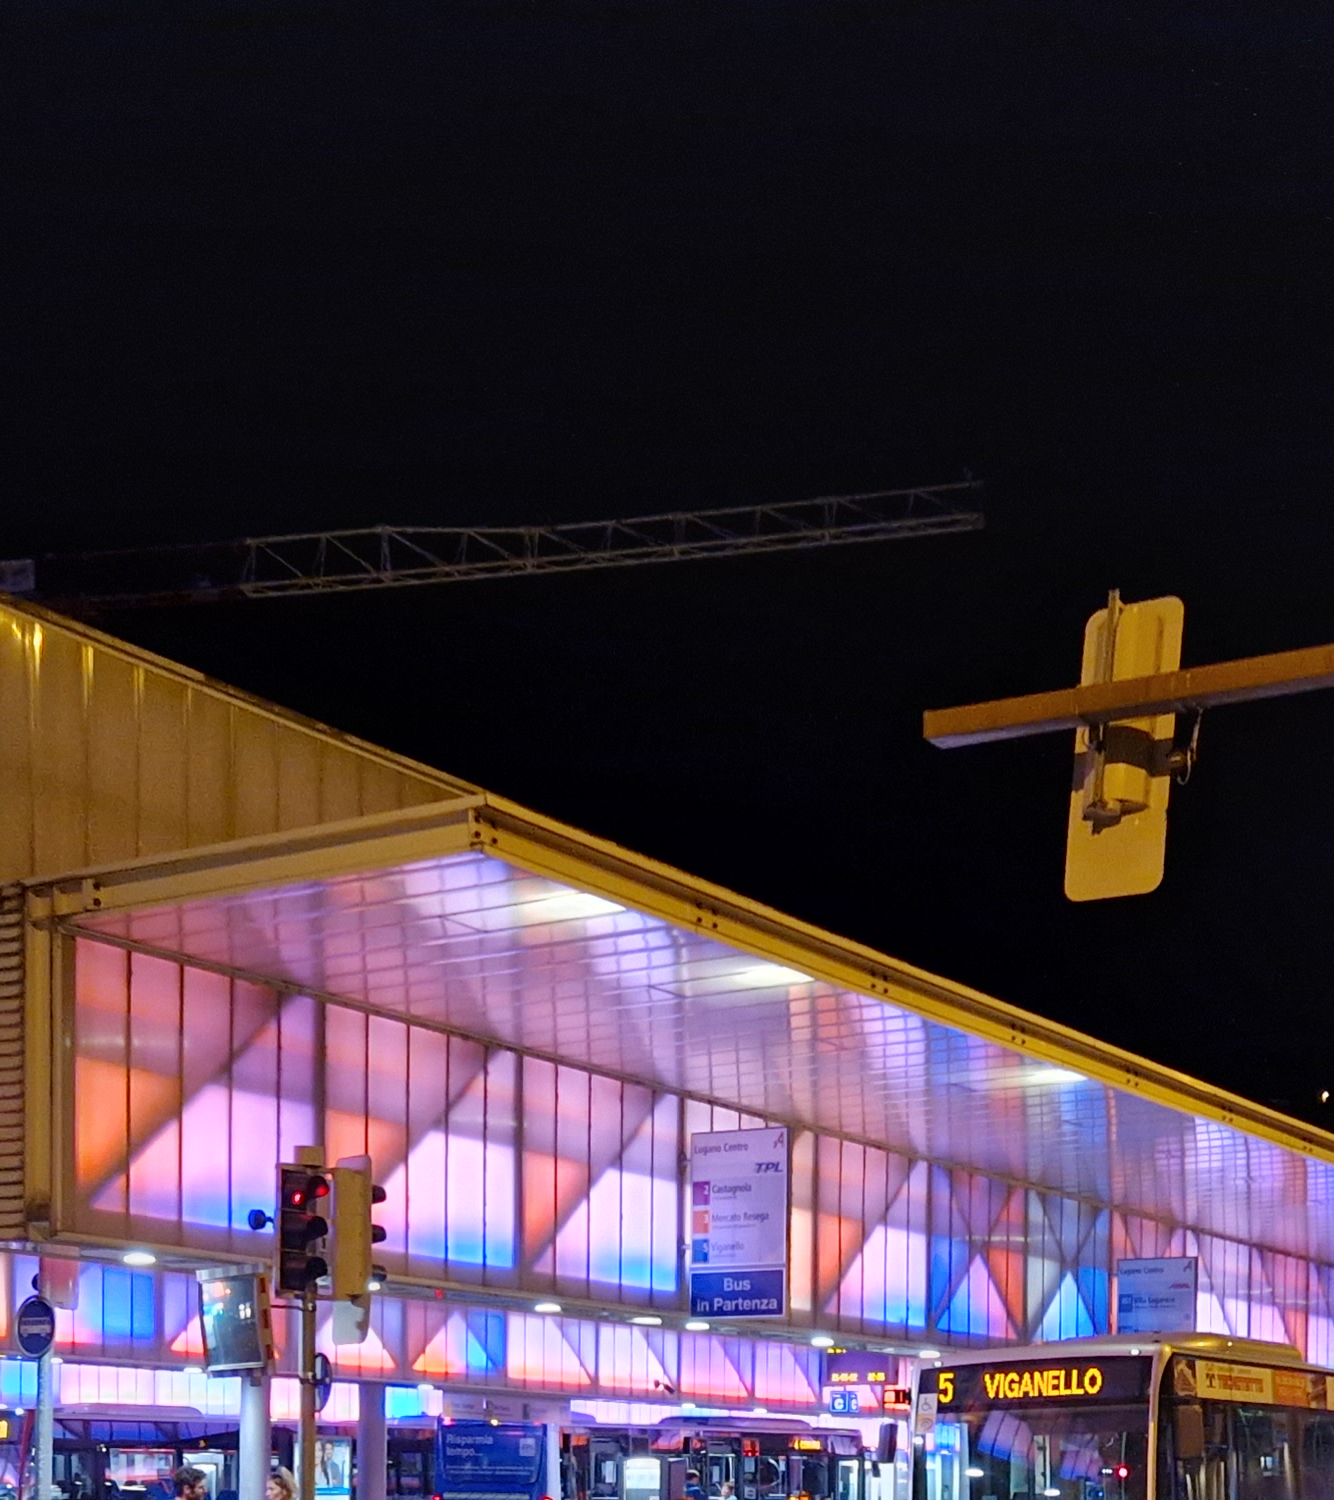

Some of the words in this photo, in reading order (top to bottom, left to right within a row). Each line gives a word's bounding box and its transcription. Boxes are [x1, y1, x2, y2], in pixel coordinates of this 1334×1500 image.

[694, 1145, 721, 1156] Lugano
[723, 1143, 748, 1152] Centro
[755, 1162, 783, 1173] TPL
[712, 1182, 752, 1195] Castagnola
[723, 1277, 751, 1291] Bus
[696, 1298, 710, 1312] in
[713, 1297, 778, 1312] Partenza
[938, 1372, 954, 1403] 5
[983, 1368, 1102, 1400] VIGANELLO
